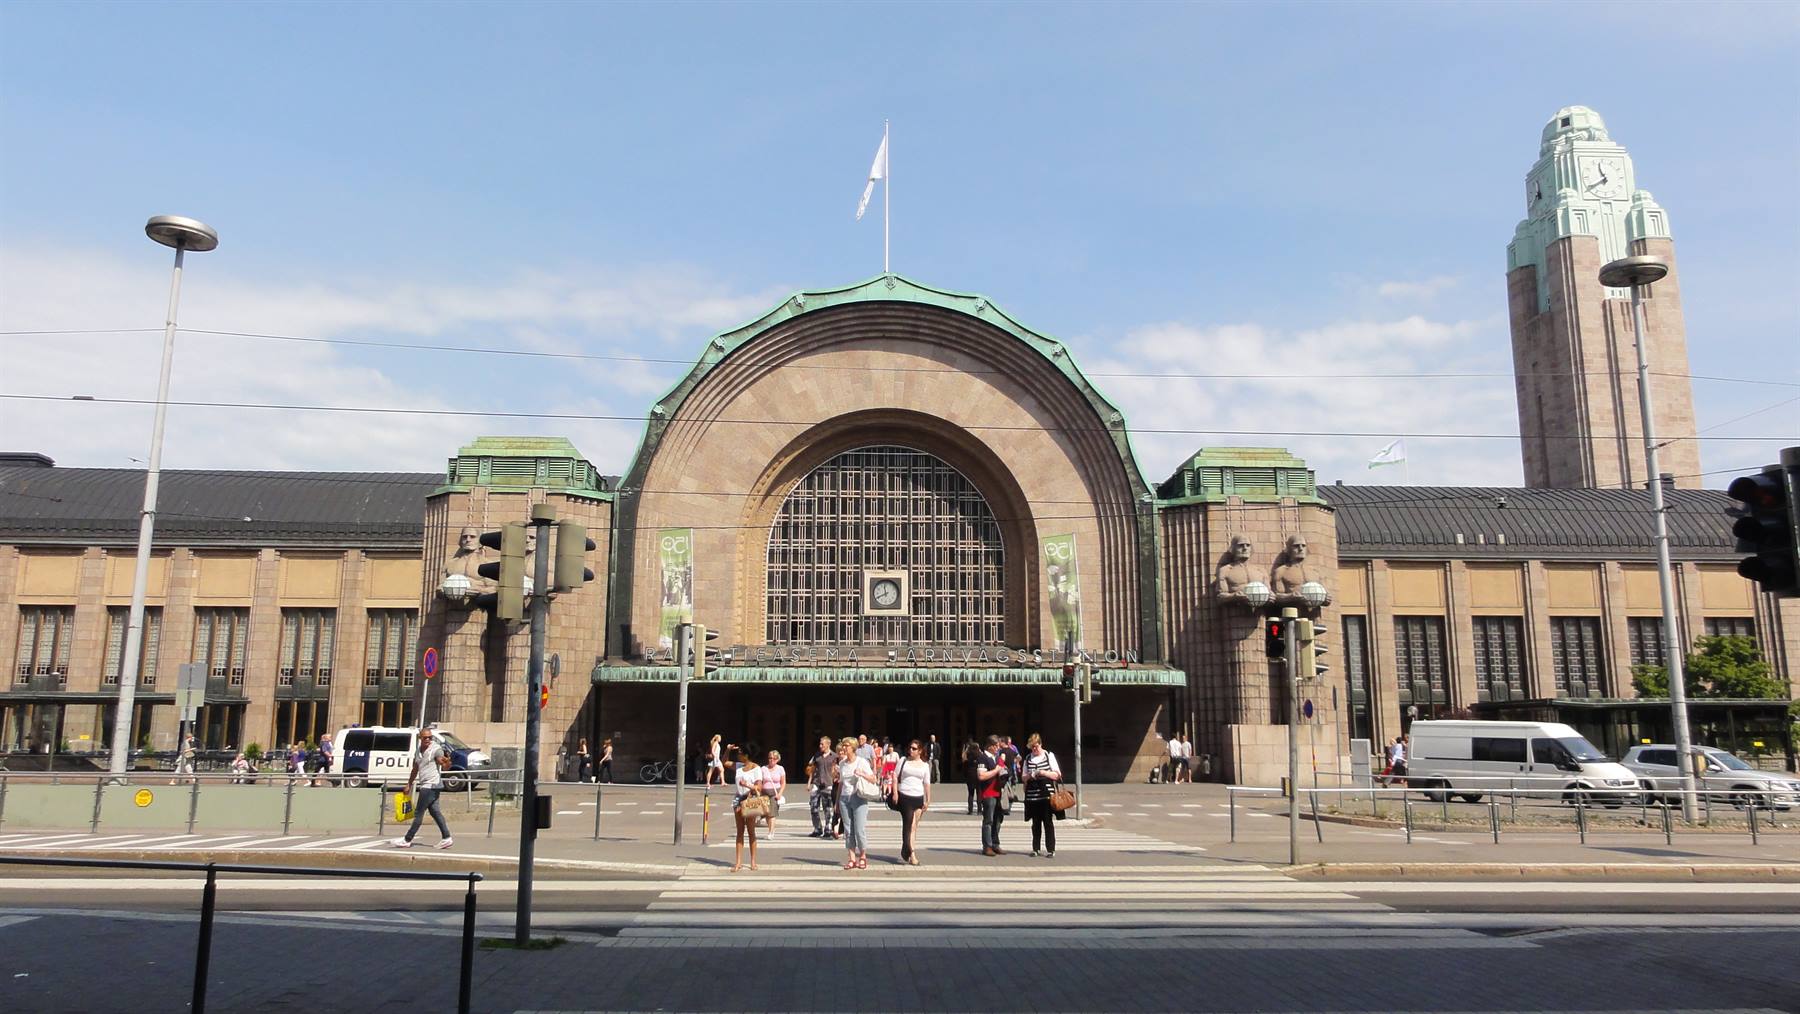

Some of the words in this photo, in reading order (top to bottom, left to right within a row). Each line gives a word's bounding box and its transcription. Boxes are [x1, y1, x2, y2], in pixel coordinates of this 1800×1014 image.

[645, 647, 859, 661] RAATIEASEMA
[889, 646, 1137, 663] JÄRNVÄGSSTTION
[375, 757, 410, 767] POLI
